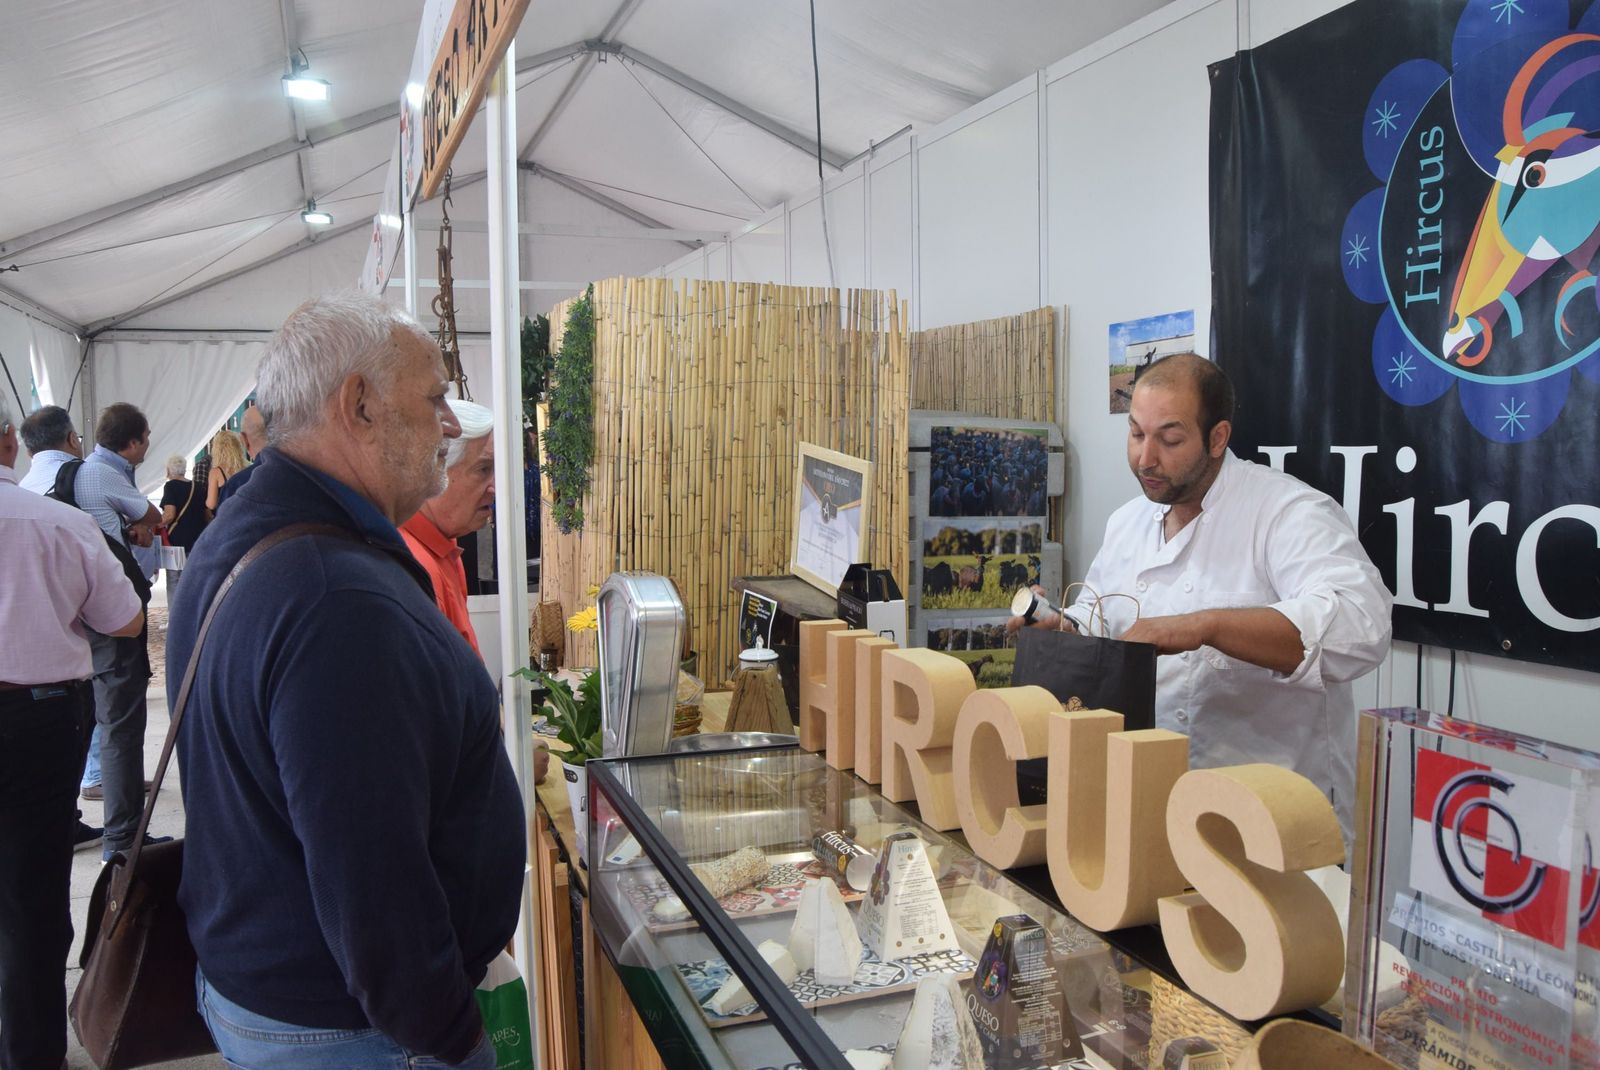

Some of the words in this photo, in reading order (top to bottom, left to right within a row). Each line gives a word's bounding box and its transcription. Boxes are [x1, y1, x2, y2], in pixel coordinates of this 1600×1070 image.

[423, 28, 459, 179] QUESO
[1404, 125, 1444, 308] Hircus
[799, 619, 1344, 1021] HIRCUS
[822, 830, 855, 855] Hircus
[966, 993, 1000, 1032] QUESO
